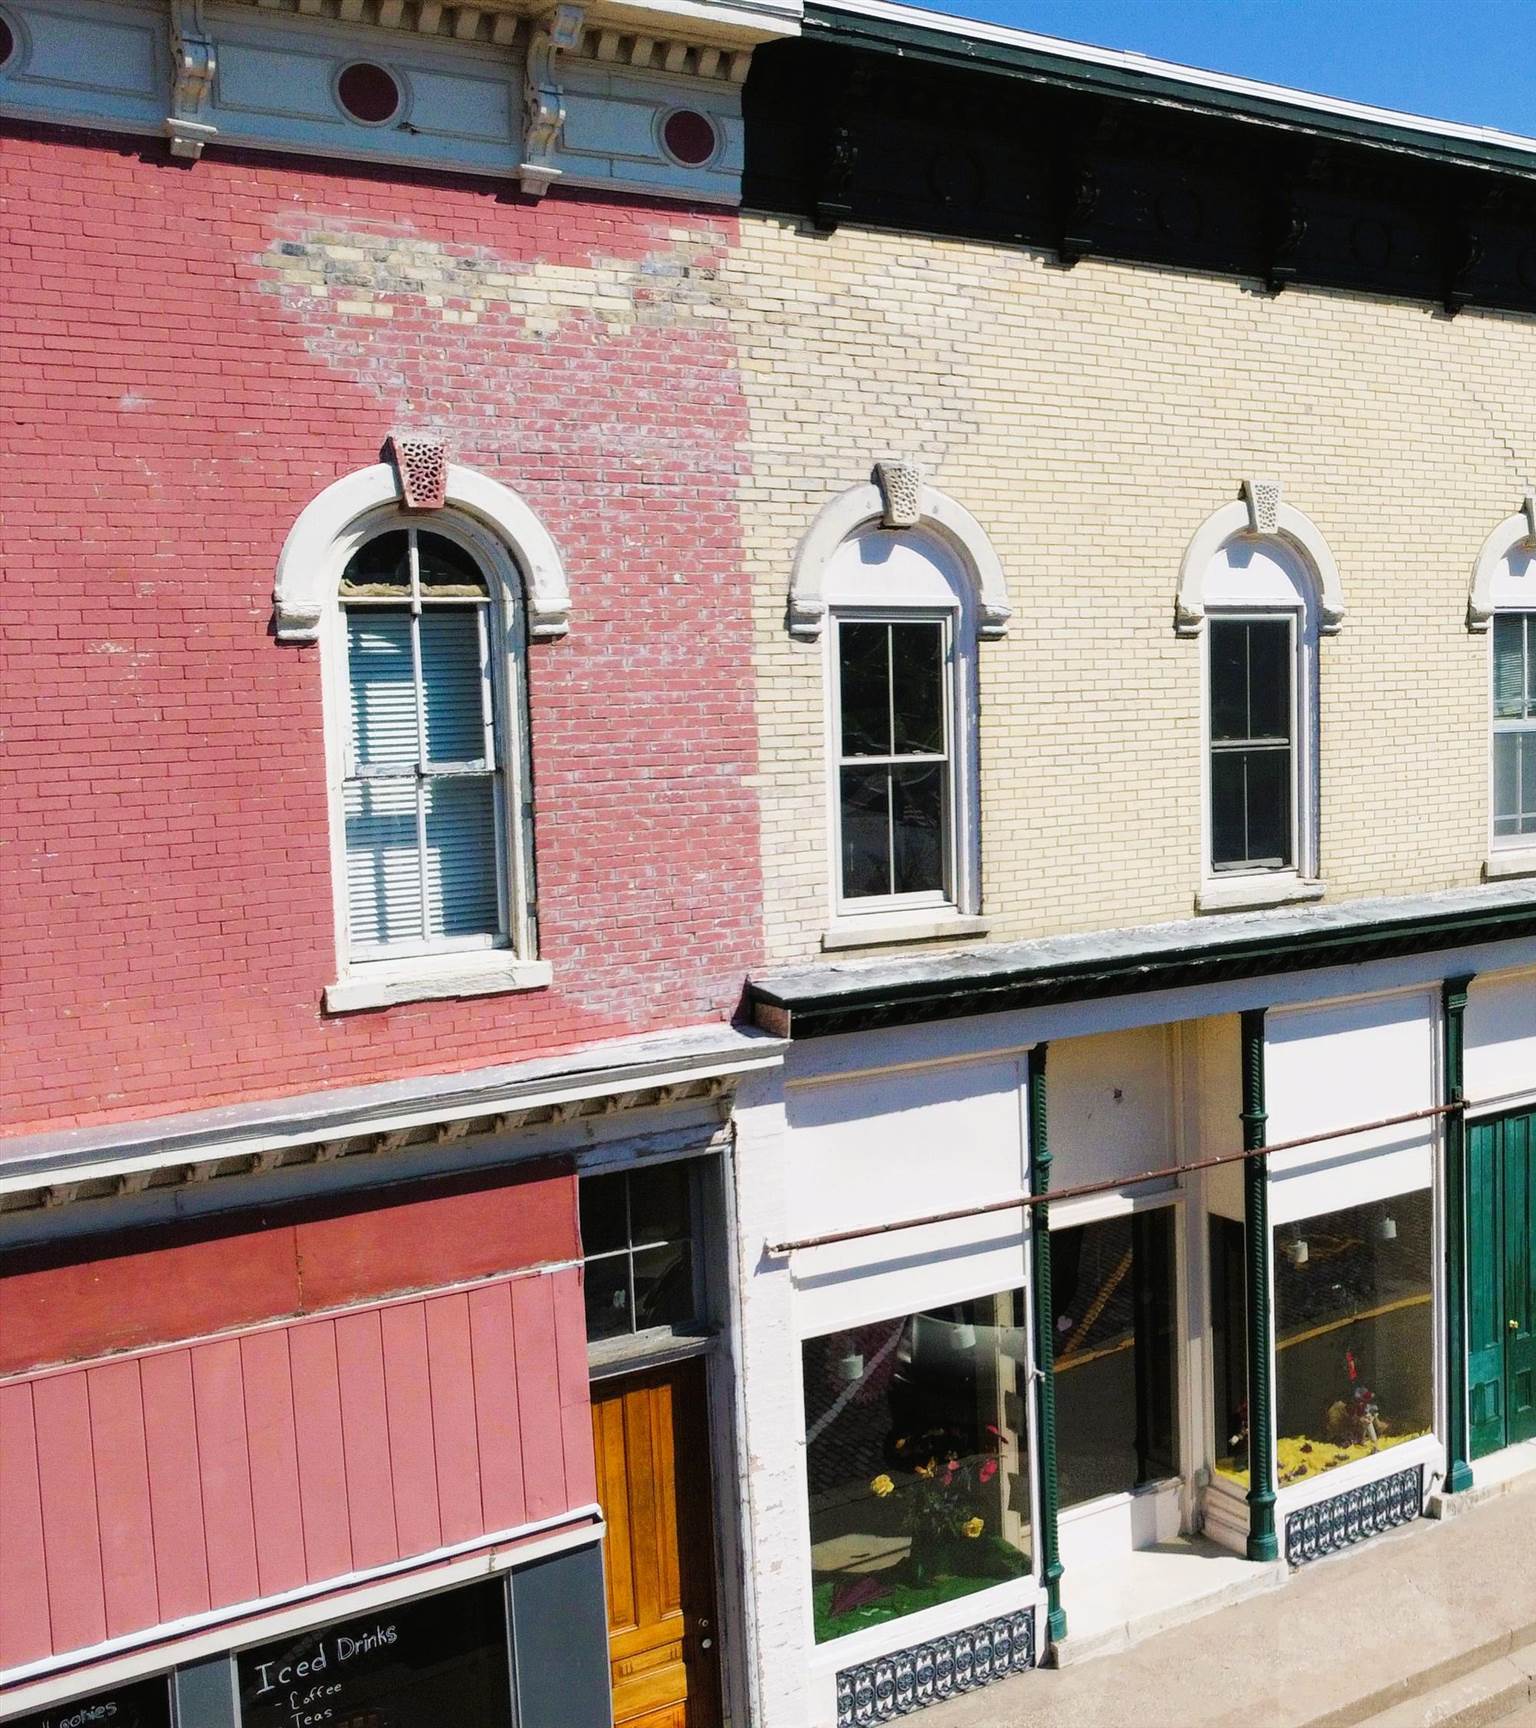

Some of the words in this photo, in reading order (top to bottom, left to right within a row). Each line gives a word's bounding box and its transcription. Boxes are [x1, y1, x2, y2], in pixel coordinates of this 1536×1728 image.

[254, 1643, 326, 1695] Iced
[337, 1625, 398, 1661] Drinks
[290, 1682, 342, 1710] Coffee
[290, 1708, 333, 1728] Teas
